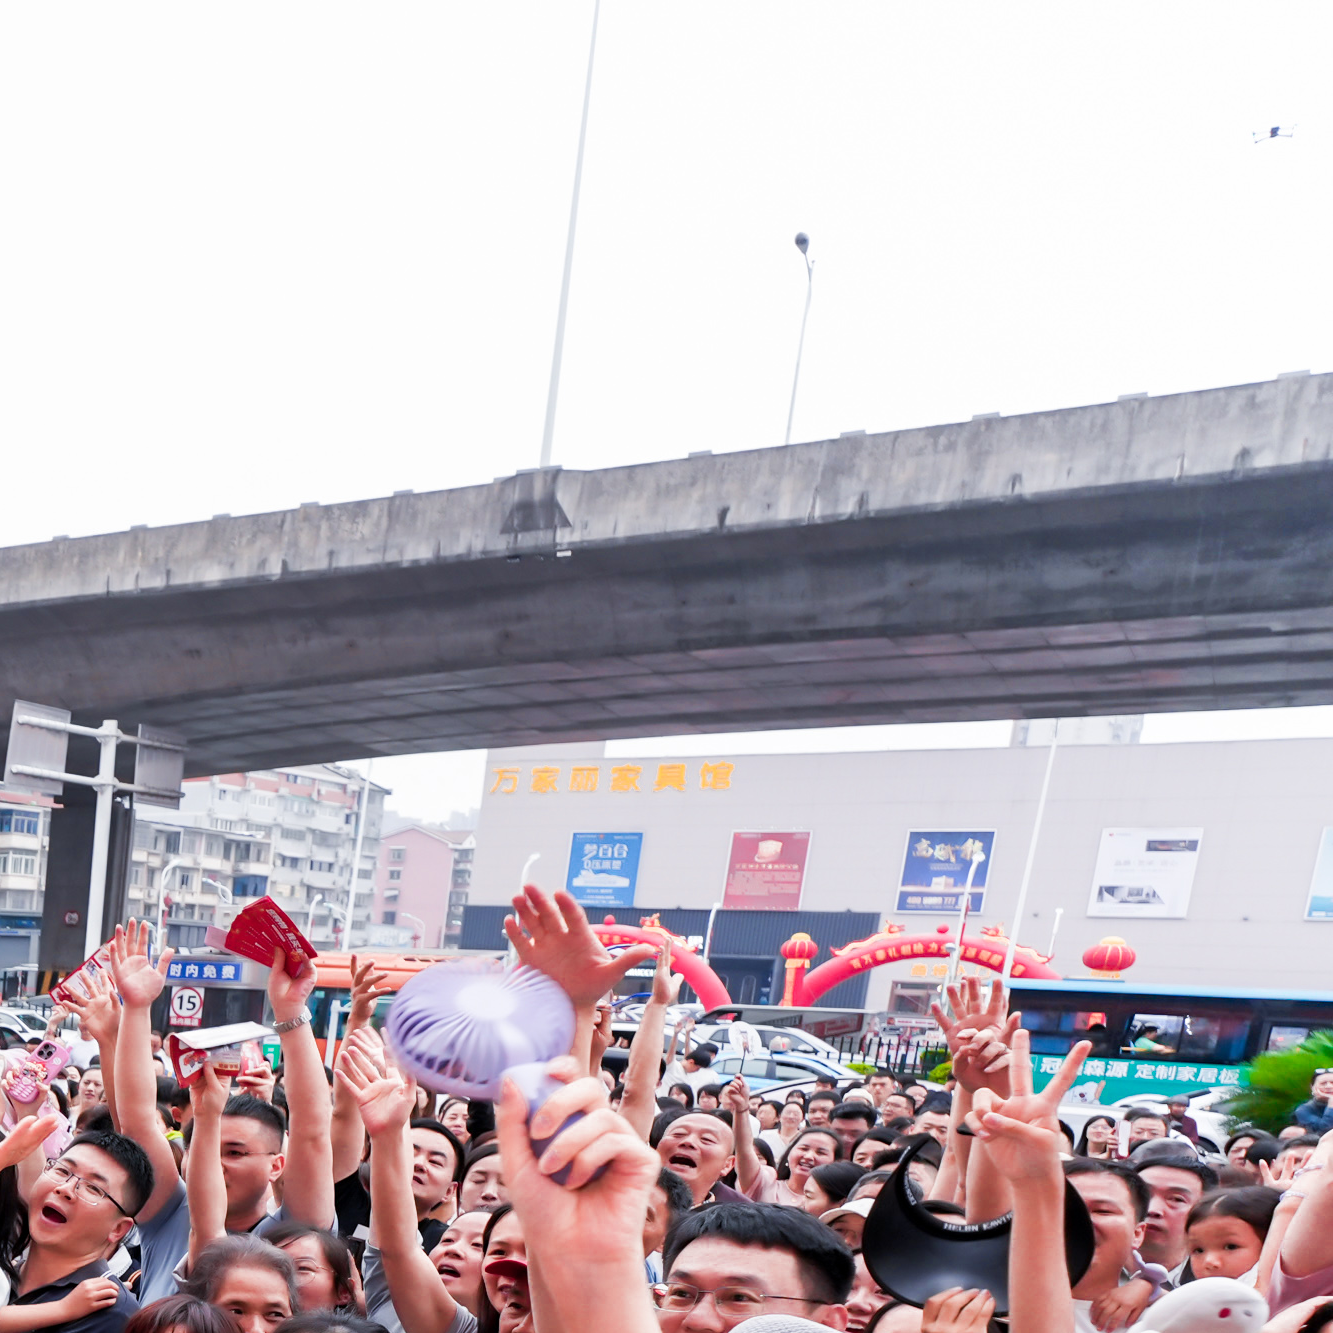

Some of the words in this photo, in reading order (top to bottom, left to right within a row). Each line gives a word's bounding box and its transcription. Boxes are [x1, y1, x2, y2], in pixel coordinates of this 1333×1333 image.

[490, 761, 735, 794] 万家丽家具馆
[177, 994, 197, 1011] 15
[1040, 1056, 1128, 1078] 冠森源
[1134, 1063, 1241, 1085] 定制家居板
